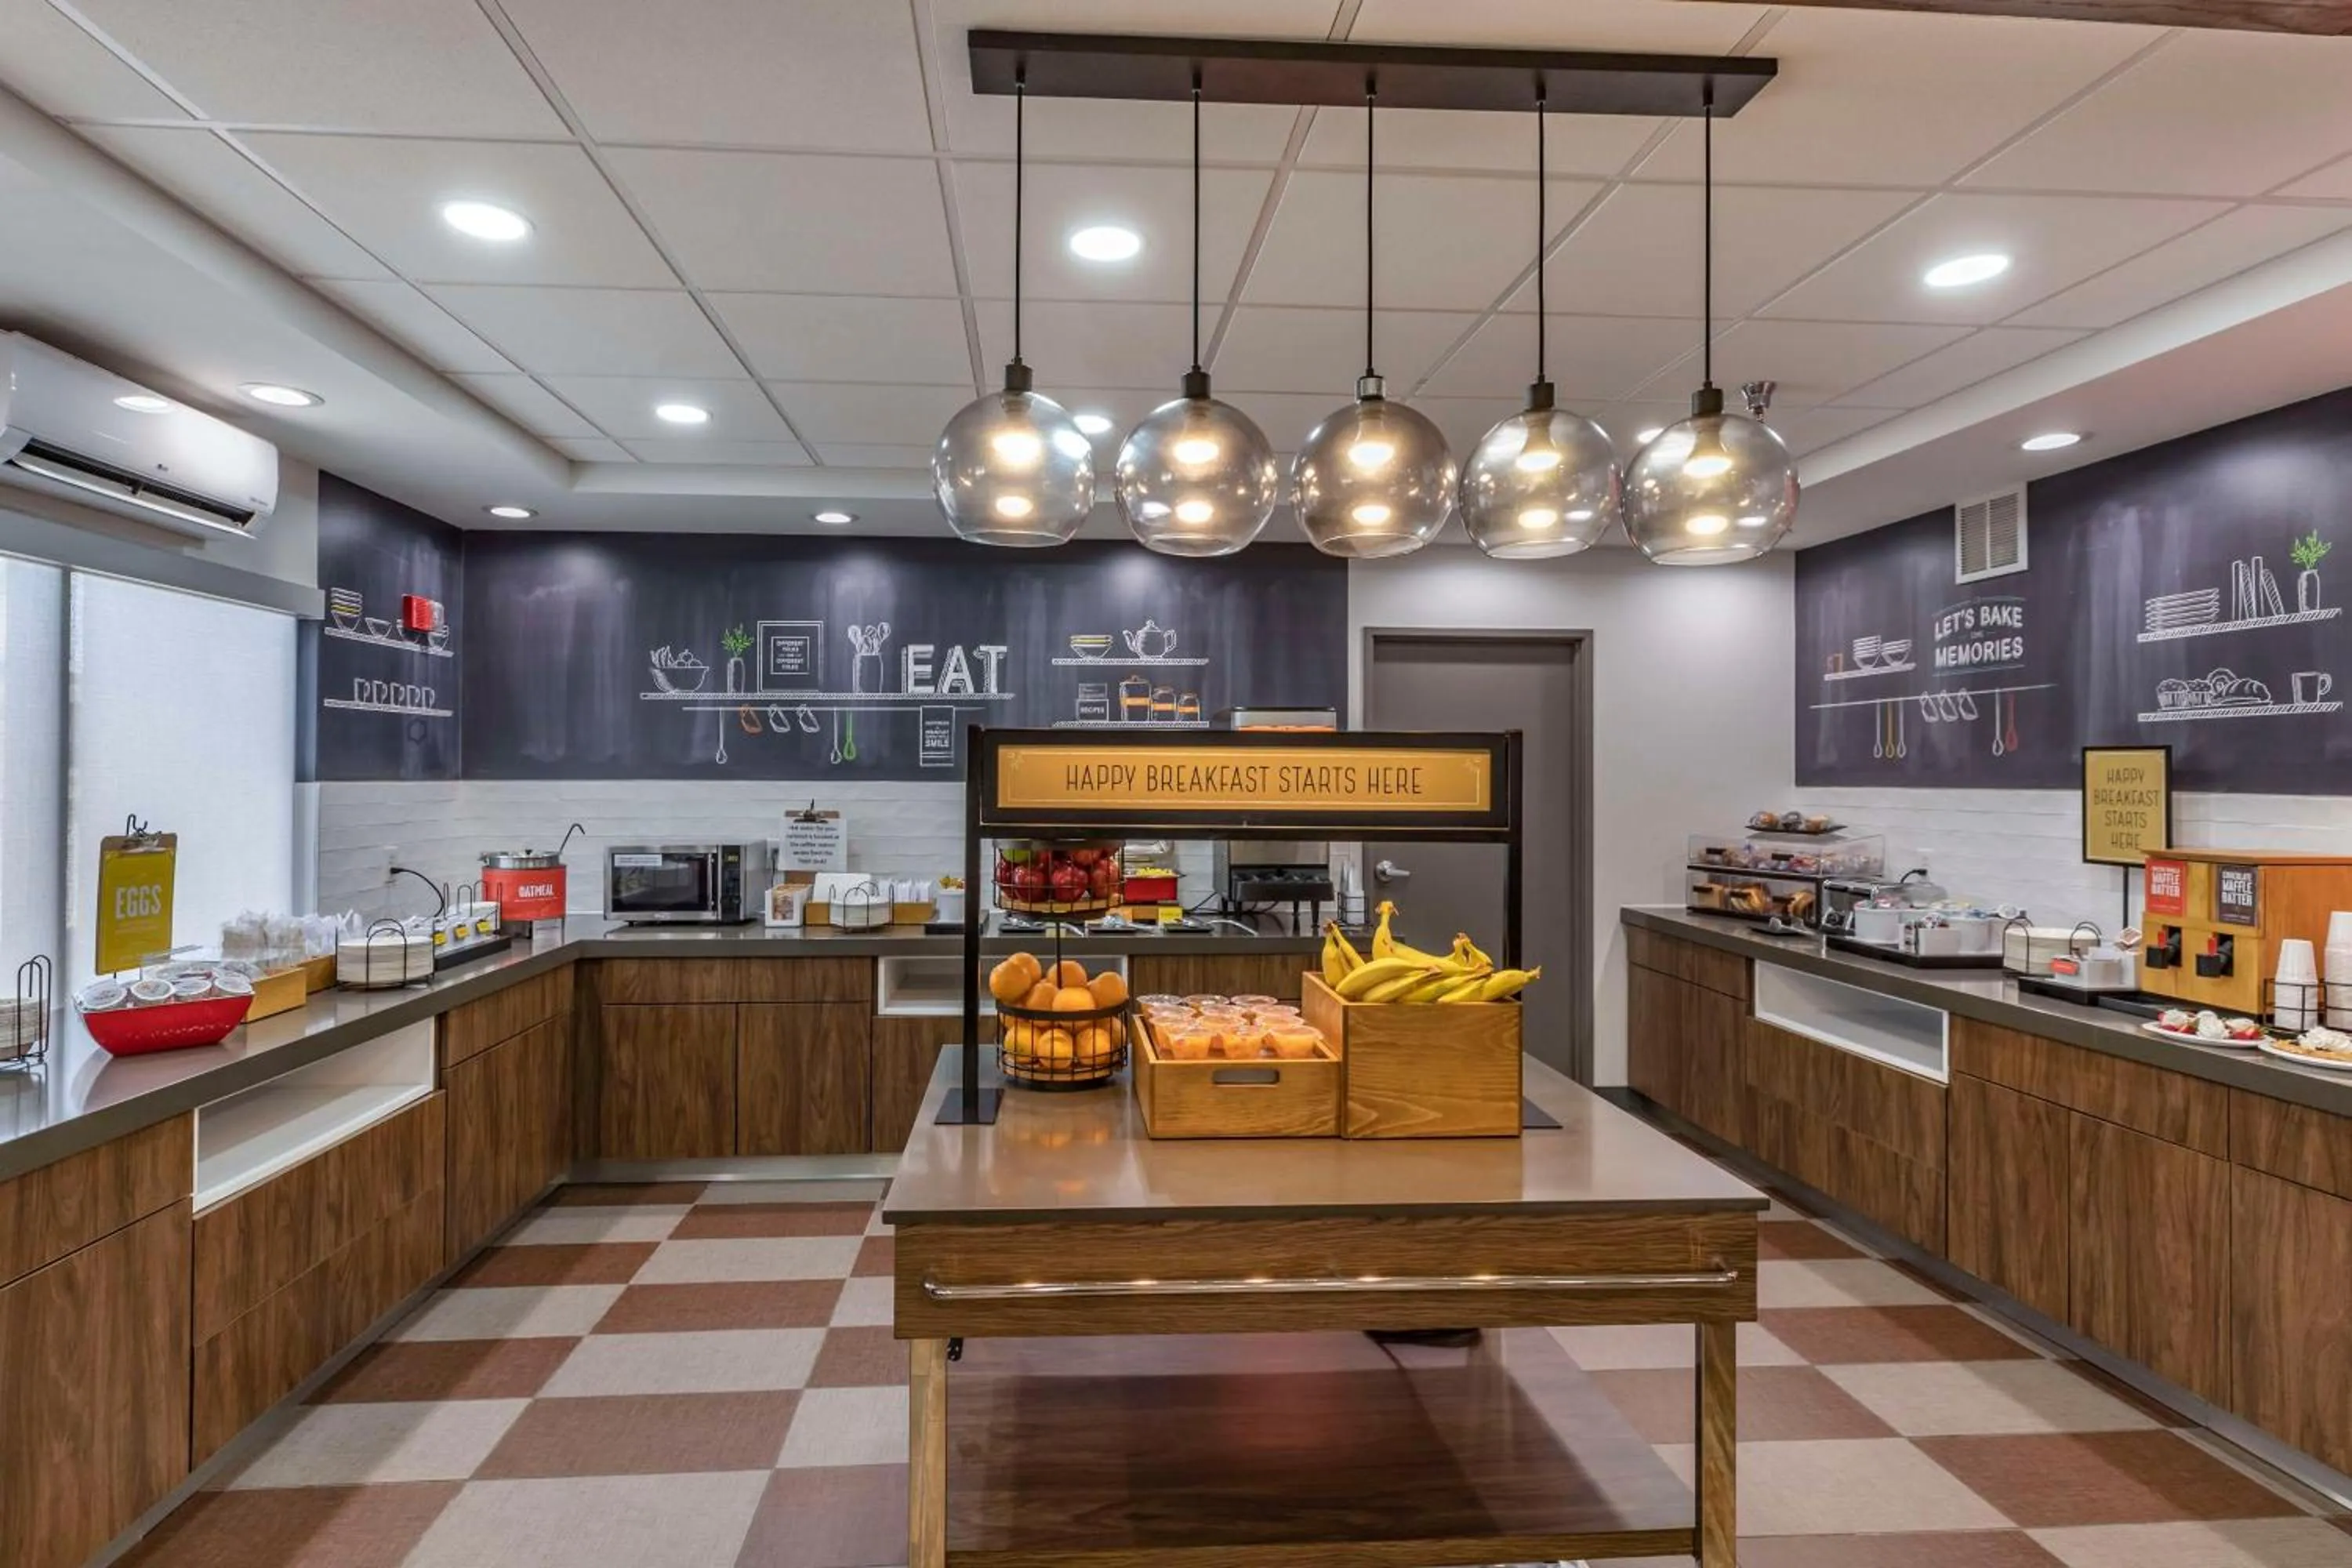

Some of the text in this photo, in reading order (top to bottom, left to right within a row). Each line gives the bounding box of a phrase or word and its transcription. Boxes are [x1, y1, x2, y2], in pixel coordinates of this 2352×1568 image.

[1934, 605, 2024, 641] LET'S BAKE
[1935, 636, 2024, 667] MEMORIES
[902, 644, 1007, 695] EAT
[1065, 764, 1423, 794] HAPPY BREAKFAST STARTS HERE
[2107, 768, 2144, 784] HAPPY
[2093, 789, 2160, 807] BREAKFAST
[2104, 809, 2147, 829] STARTS
[2111, 832, 2141, 849] HERE
[2152, 872, 2180, 885] WAFFLE
[2222, 879, 2254, 895] WAFFLE
[518, 884, 554, 898] OATMEAL
[2151, 884, 2180, 898] BATTER
[2221, 891, 2252, 906] BATTER
[115, 884, 163, 920] EGGS
